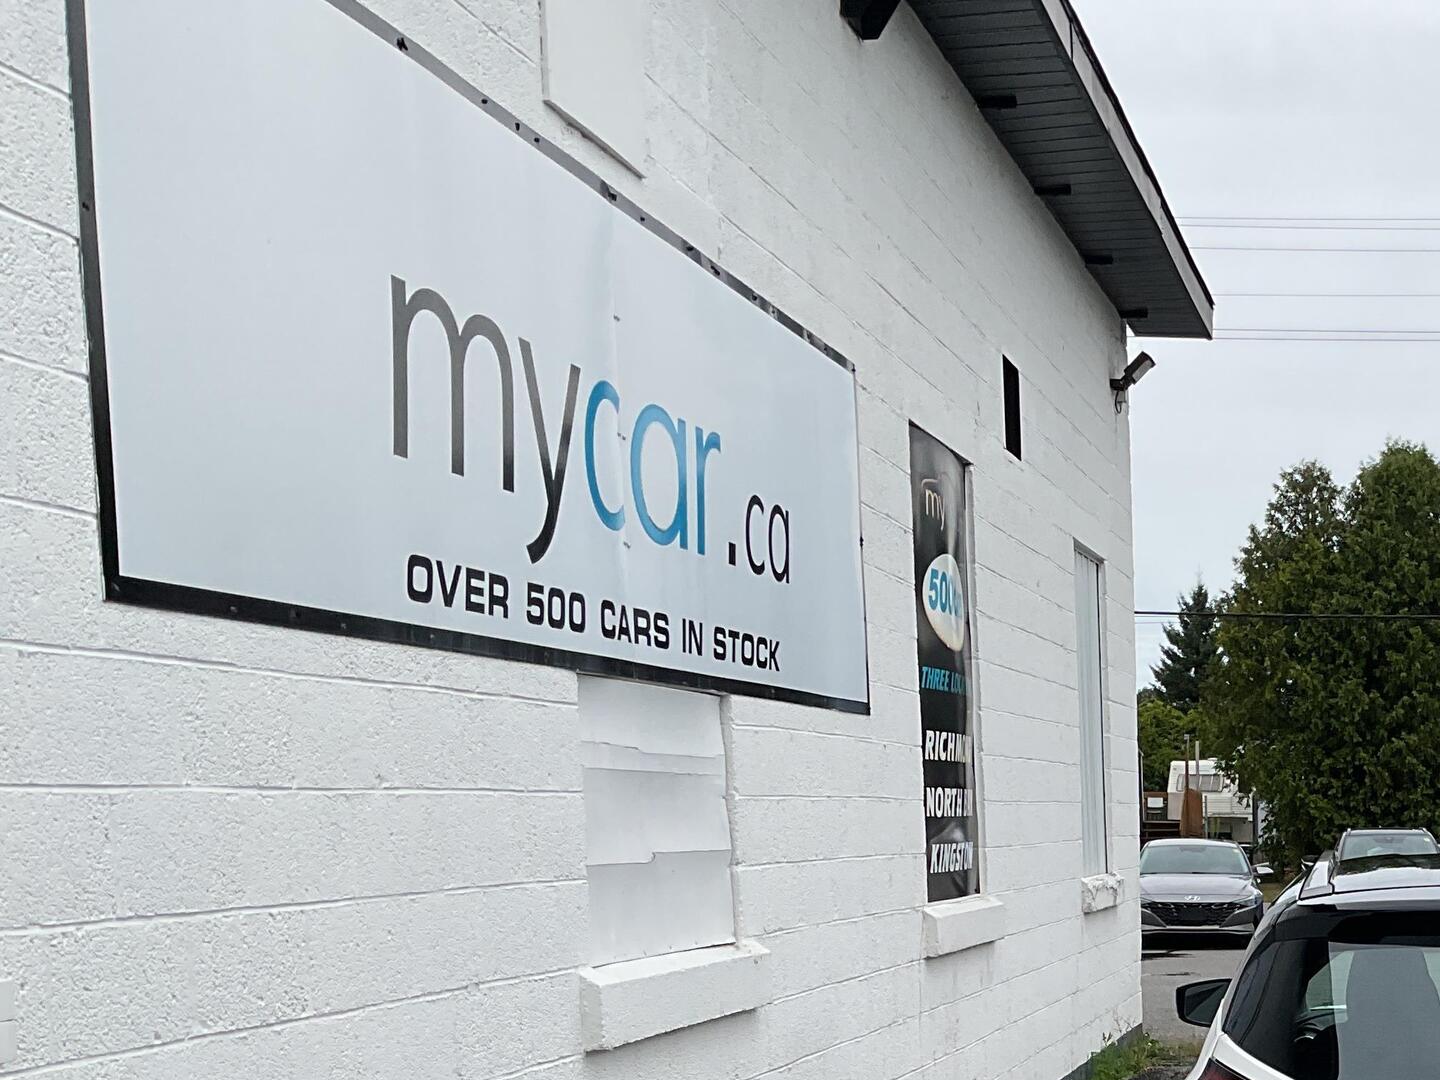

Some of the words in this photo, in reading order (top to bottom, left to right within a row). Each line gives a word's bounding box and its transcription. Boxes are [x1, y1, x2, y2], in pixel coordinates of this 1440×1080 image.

[407, 554, 509, 619] OVER
[526, 582, 586, 634] 500
[601, 600, 670, 650] CARS
[682, 618, 703, 656] IN
[713, 627, 780, 672] STOCK
[921, 666, 950, 692] THREE
[926, 786, 962, 817] NORTH
